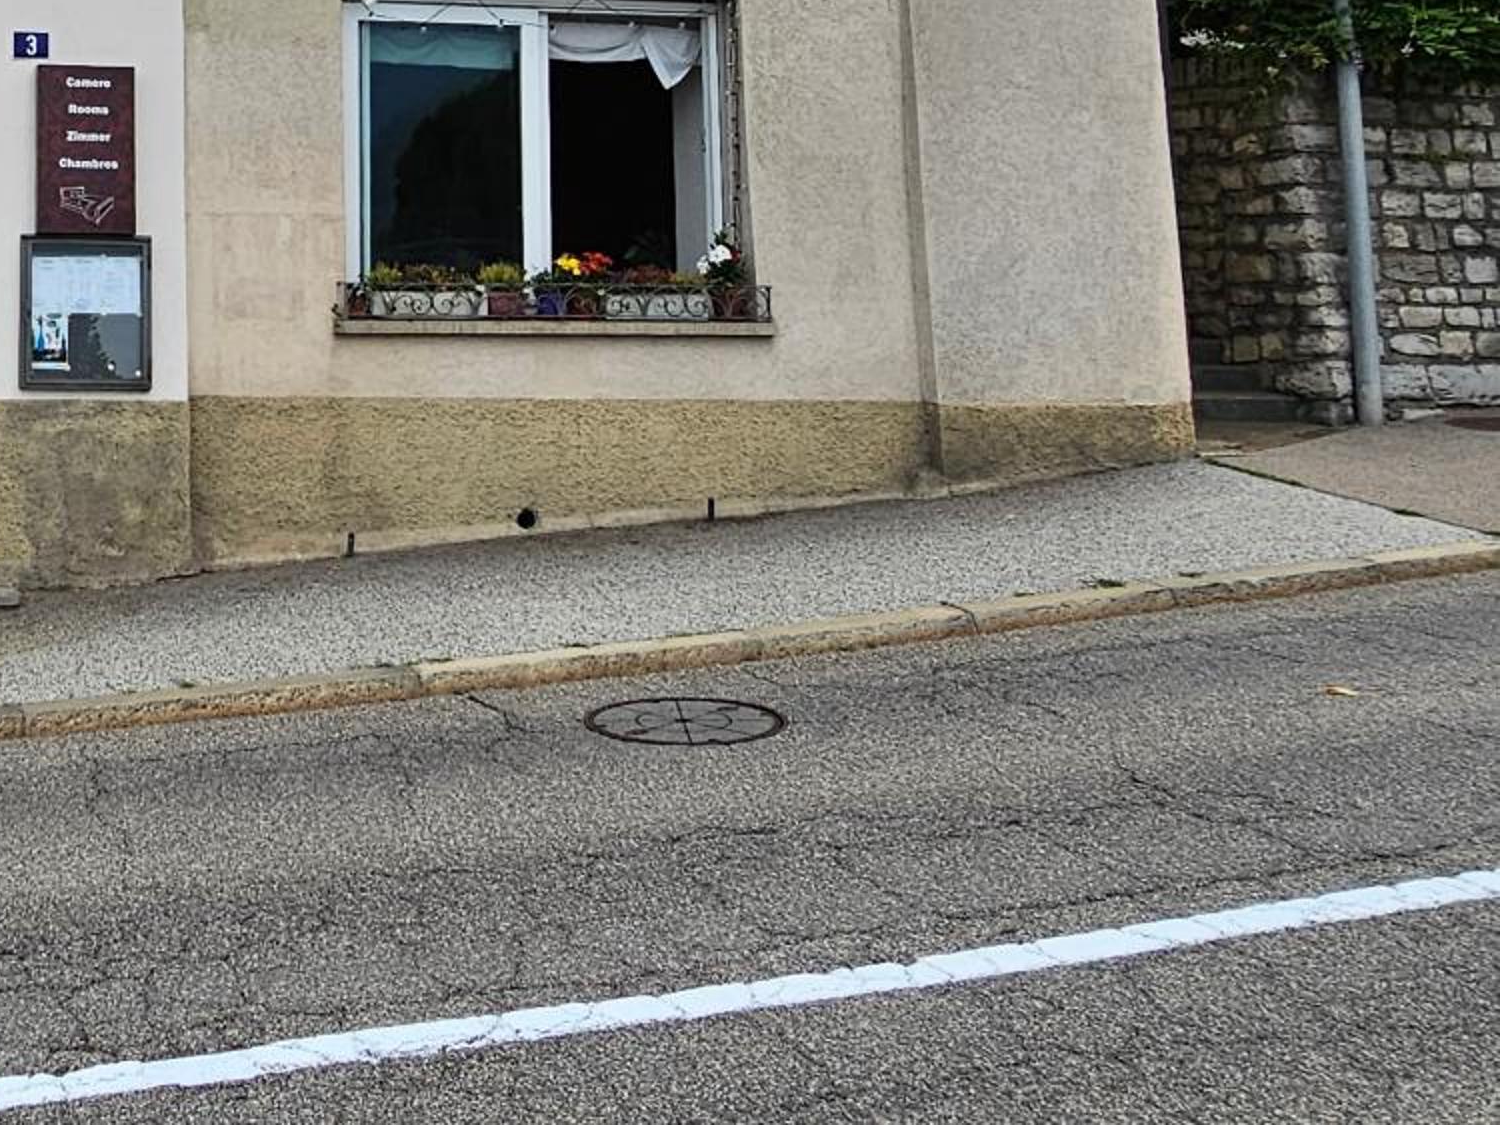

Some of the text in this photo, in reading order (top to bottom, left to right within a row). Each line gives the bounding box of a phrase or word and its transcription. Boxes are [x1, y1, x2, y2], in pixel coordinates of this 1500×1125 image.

[25, 34, 37, 56] 3
[68, 103, 109, 115] Rooms
[65, 130, 111, 142] Zimmer
[58, 157, 119, 170] Chambres
